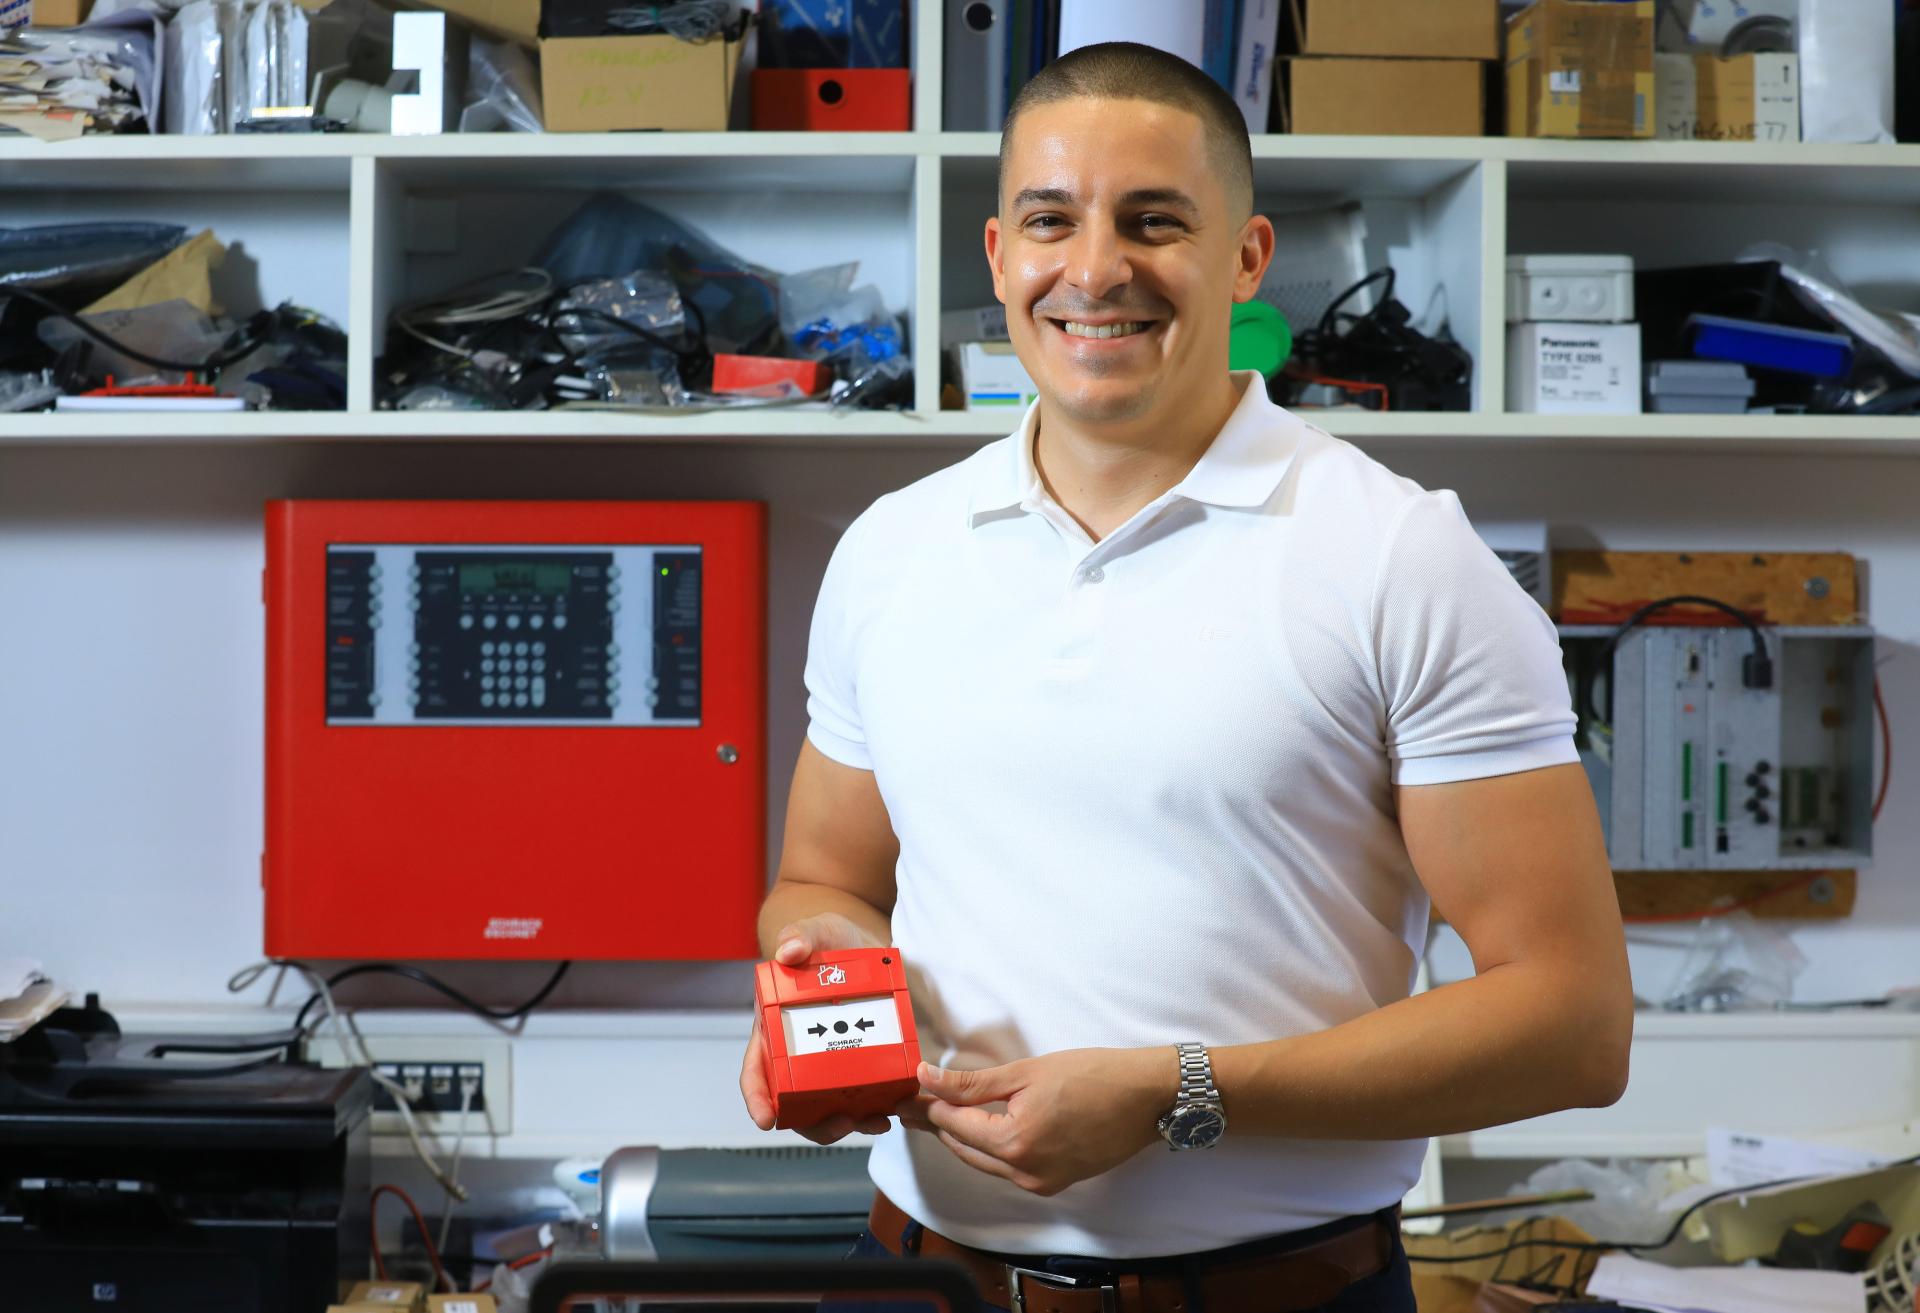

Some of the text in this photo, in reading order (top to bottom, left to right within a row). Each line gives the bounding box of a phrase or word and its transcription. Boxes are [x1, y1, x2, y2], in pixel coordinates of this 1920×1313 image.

[1541, 337, 1600, 348] Panasonic
[1542, 351, 1572, 363] TYPE
[827, 1038, 863, 1047] SCHRACK
